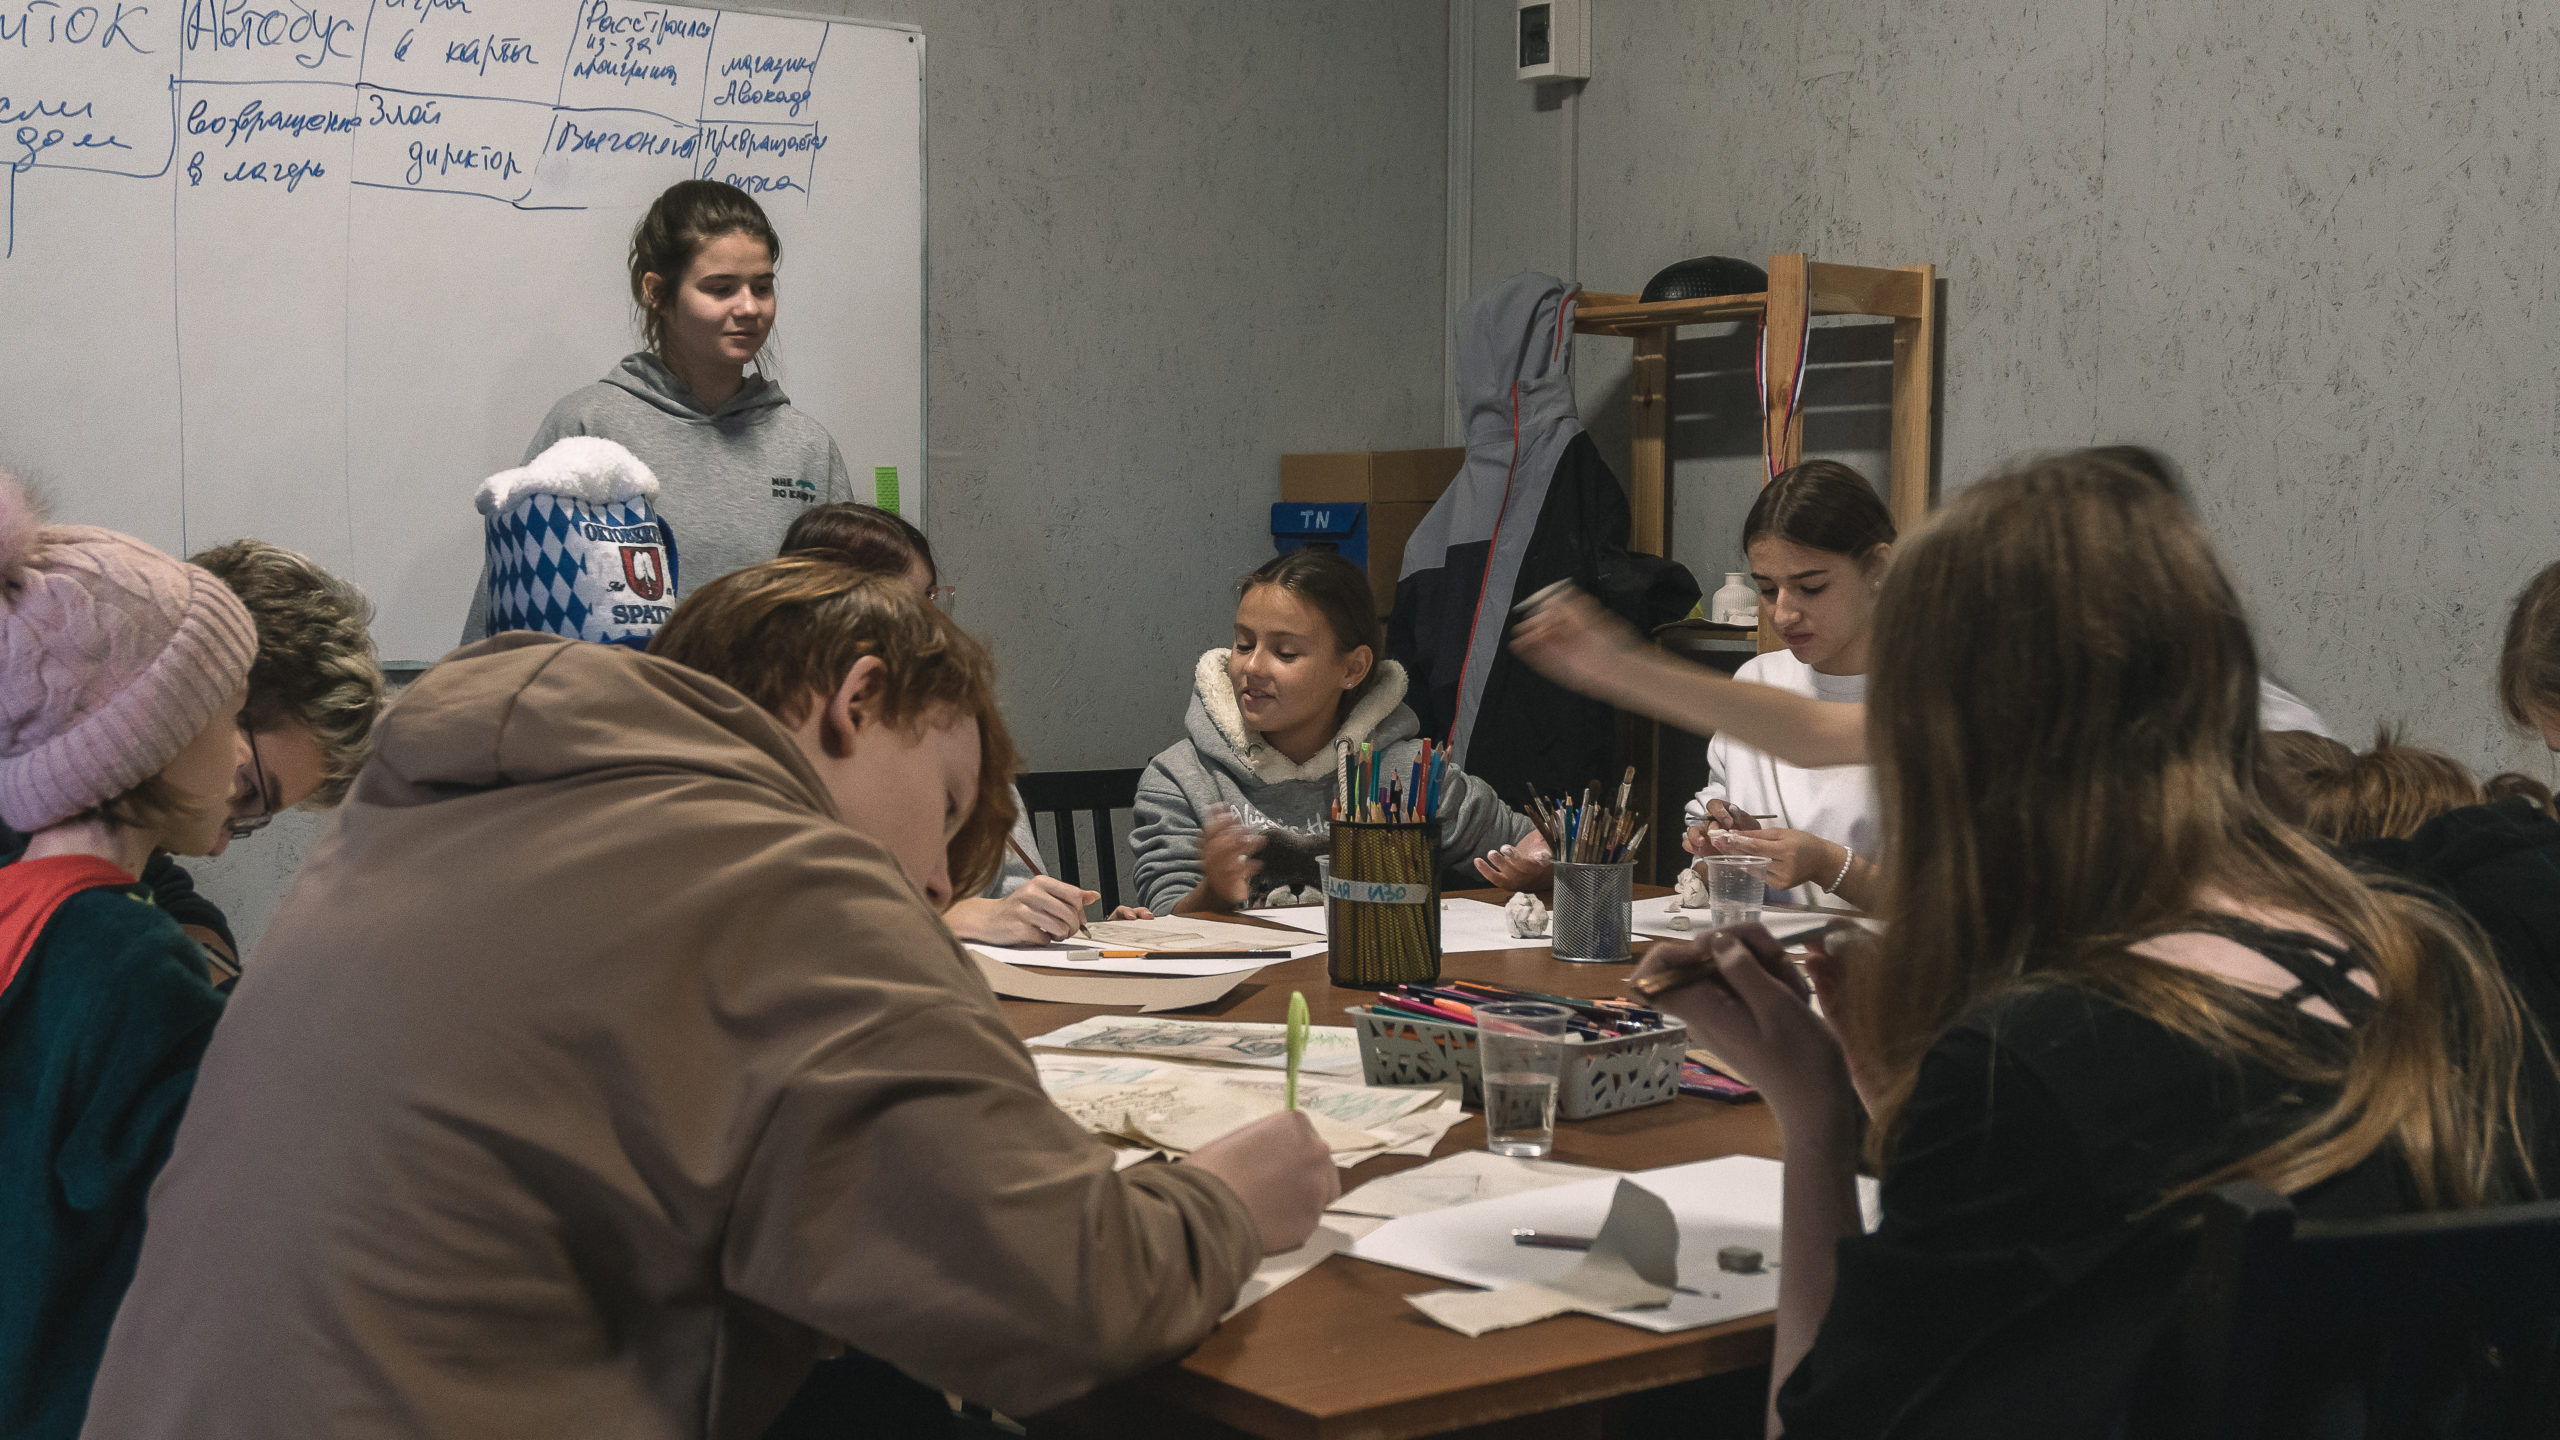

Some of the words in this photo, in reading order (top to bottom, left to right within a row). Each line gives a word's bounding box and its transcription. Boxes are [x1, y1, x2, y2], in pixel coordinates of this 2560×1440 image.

[446, 34, 539, 76] карты
[370, 94, 441, 126] Злой
[714, 80, 811, 117] Авокадо
[406, 141, 522, 185] директор
[1300, 510, 1331, 529] TN
